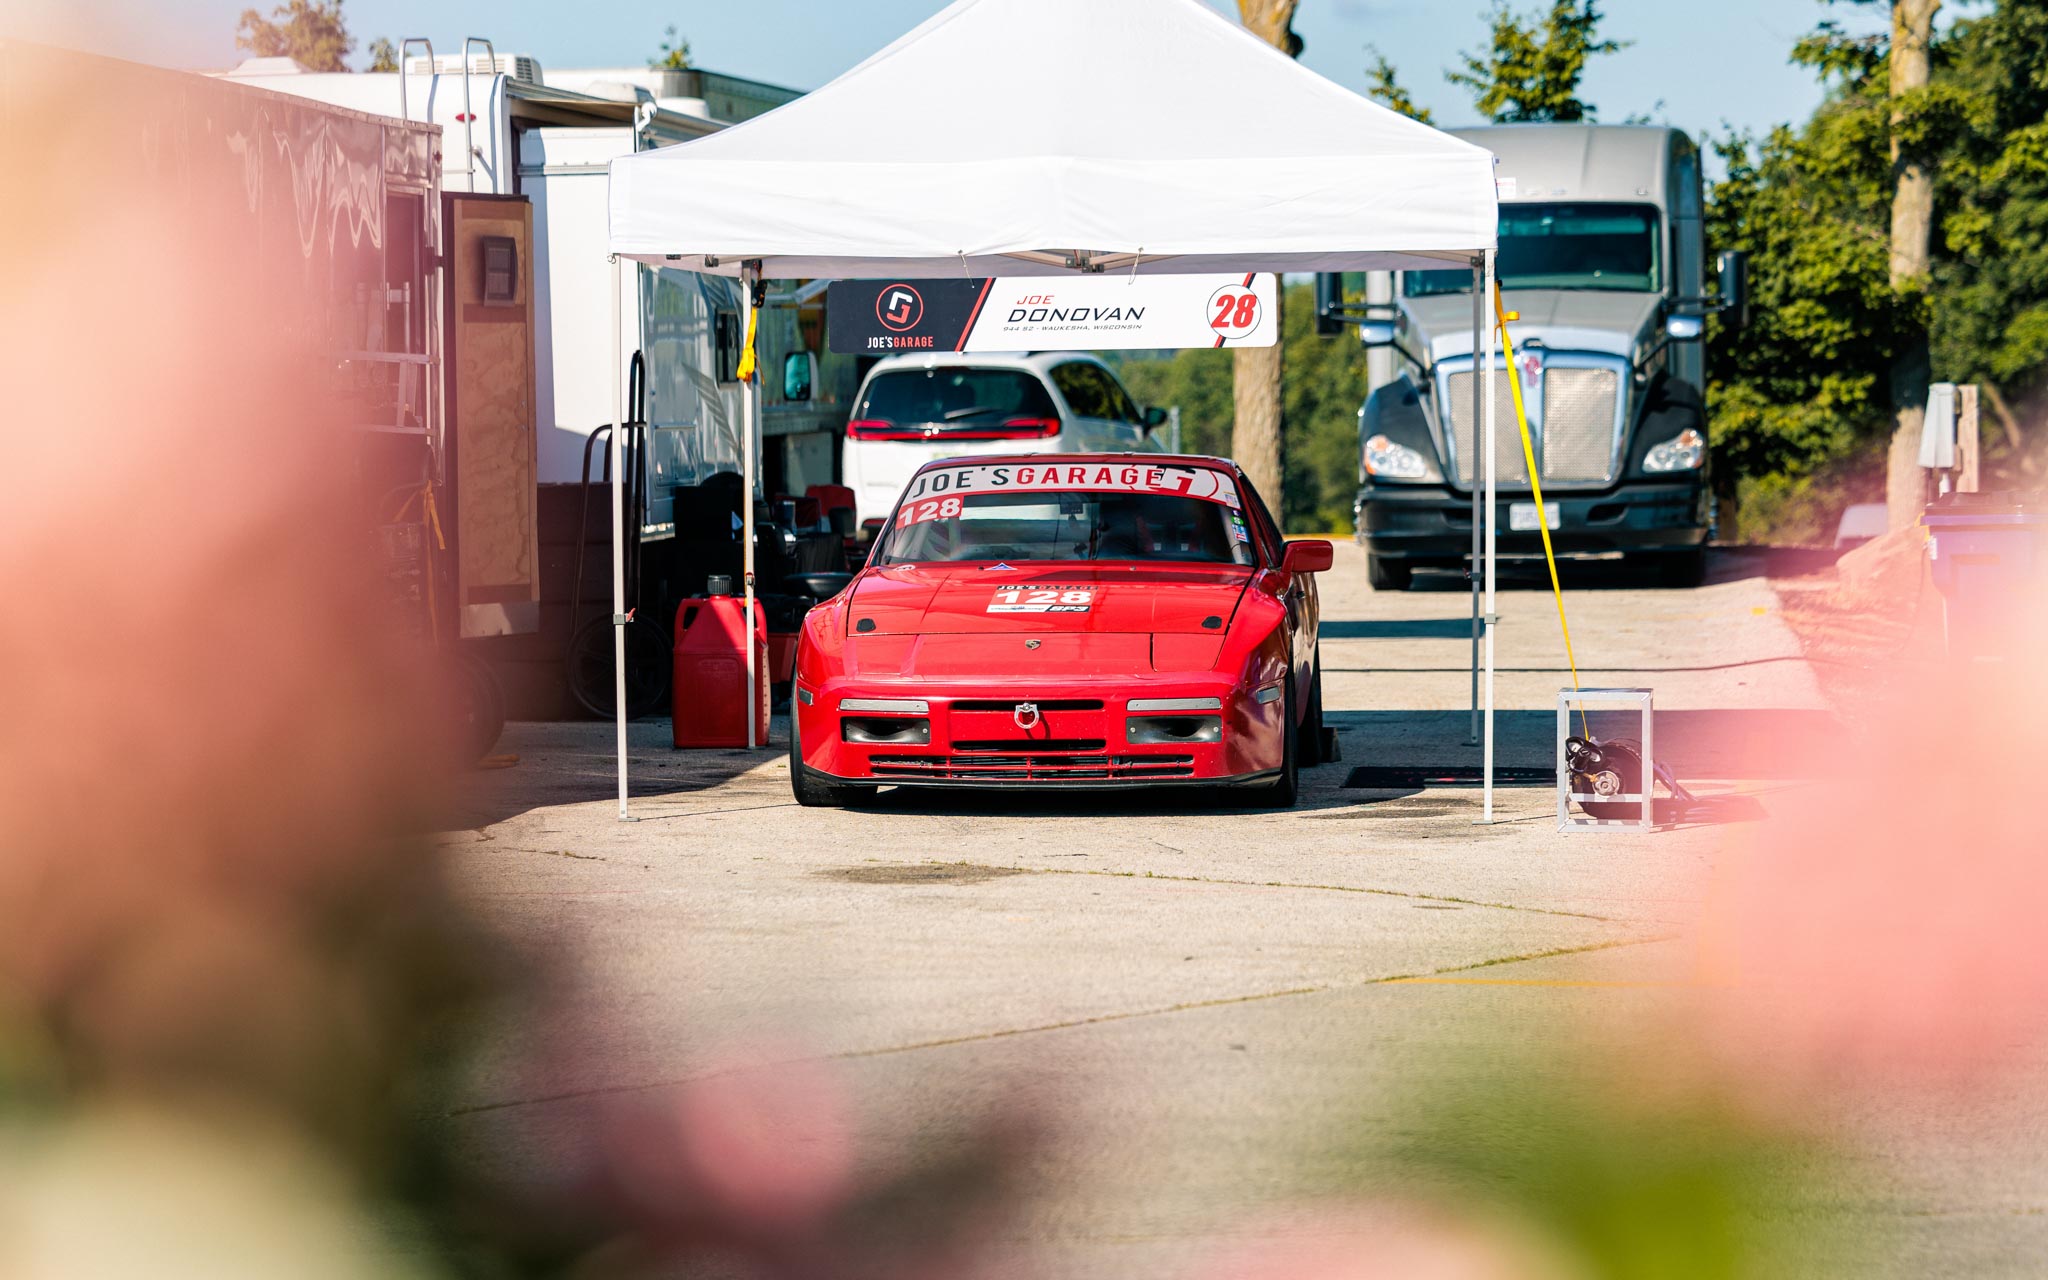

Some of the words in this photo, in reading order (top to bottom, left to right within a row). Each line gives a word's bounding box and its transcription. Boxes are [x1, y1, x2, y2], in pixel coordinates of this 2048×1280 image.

[1016, 295, 1055, 305] JOE
[1007, 307, 1146, 323] DONOVAN
[1211, 294, 1257, 328] 28
[899, 498, 961, 527] 128
[996, 591, 1092, 604] 128
